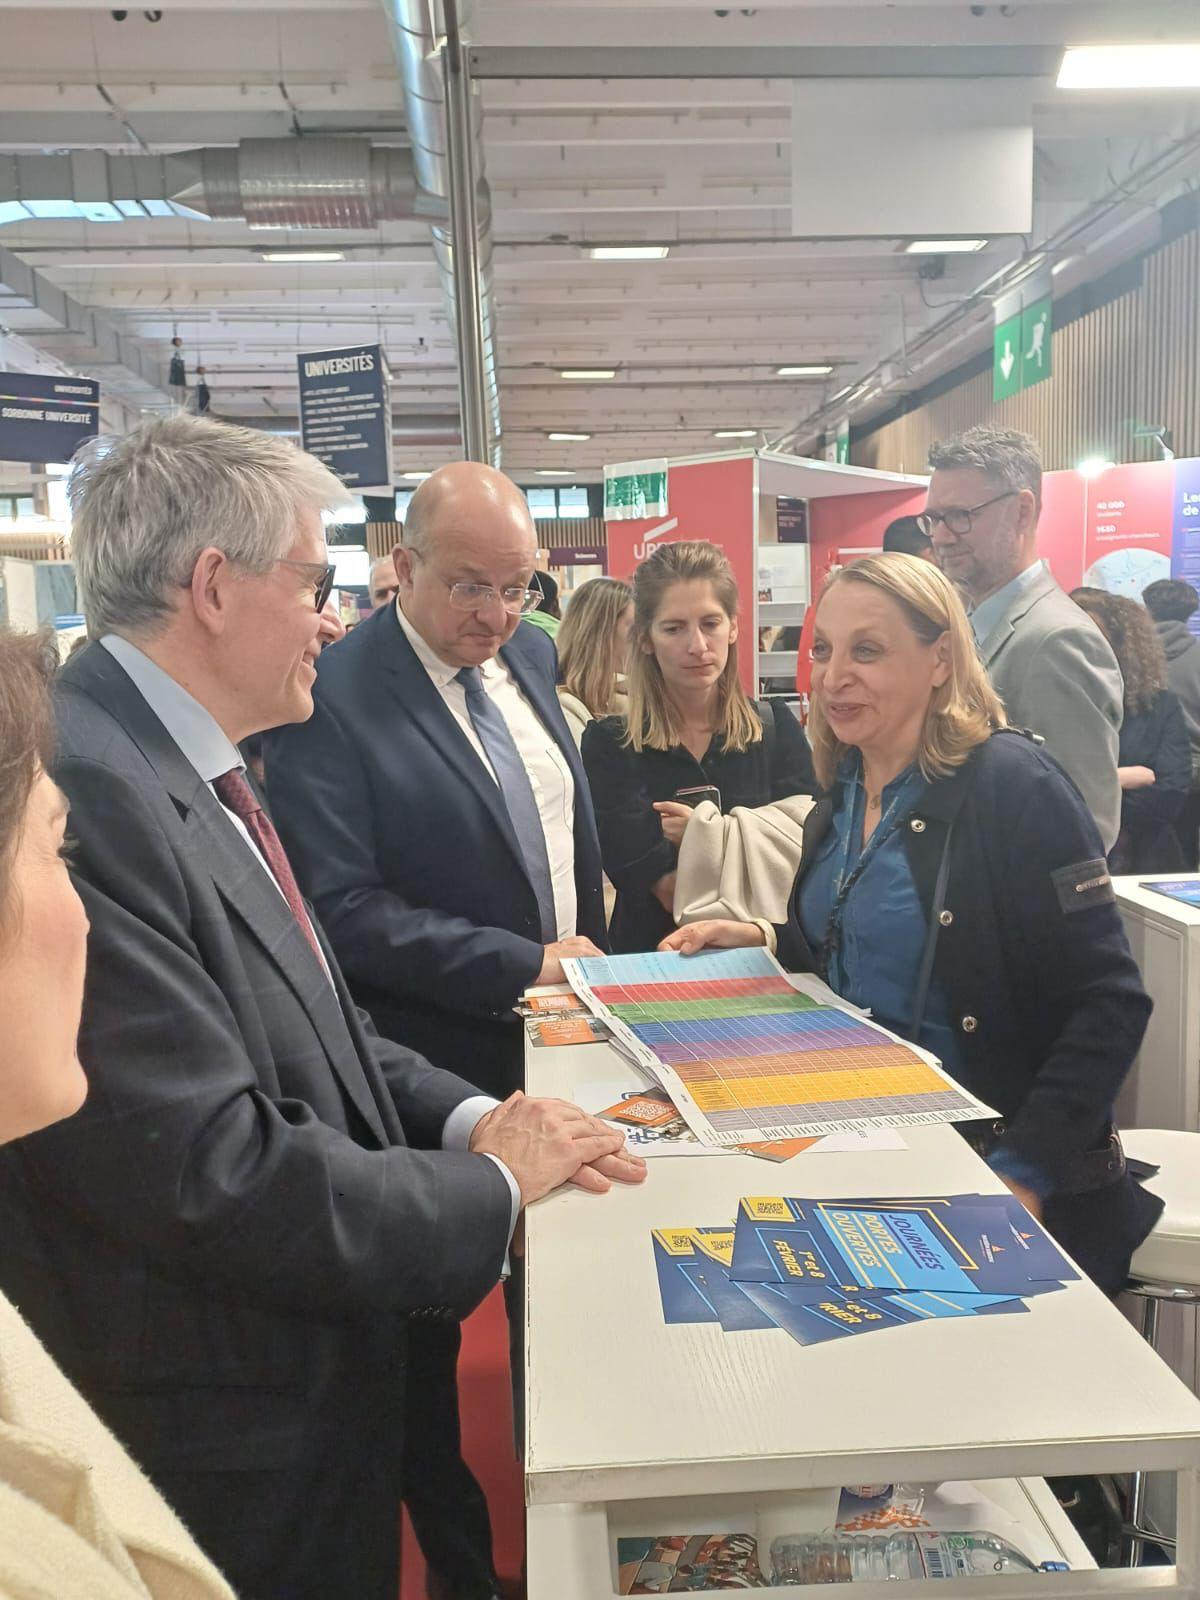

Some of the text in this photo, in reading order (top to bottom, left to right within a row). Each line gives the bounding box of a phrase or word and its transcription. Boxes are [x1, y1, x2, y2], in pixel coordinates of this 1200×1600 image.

[304, 351, 374, 377] UNIVERSITÉS
[2, 407, 91, 424] SORBONNE UNIVERSITÉ
[1183, 505, 1199, 516] de
[832, 1212, 882, 1268] OUVERTES
[861, 1213, 903, 1254] PORTES
[889, 1214, 945, 1270] JOURNÉES
[773, 1239, 804, 1277] FÉVRIER
[804, 1261, 820, 1271] et
